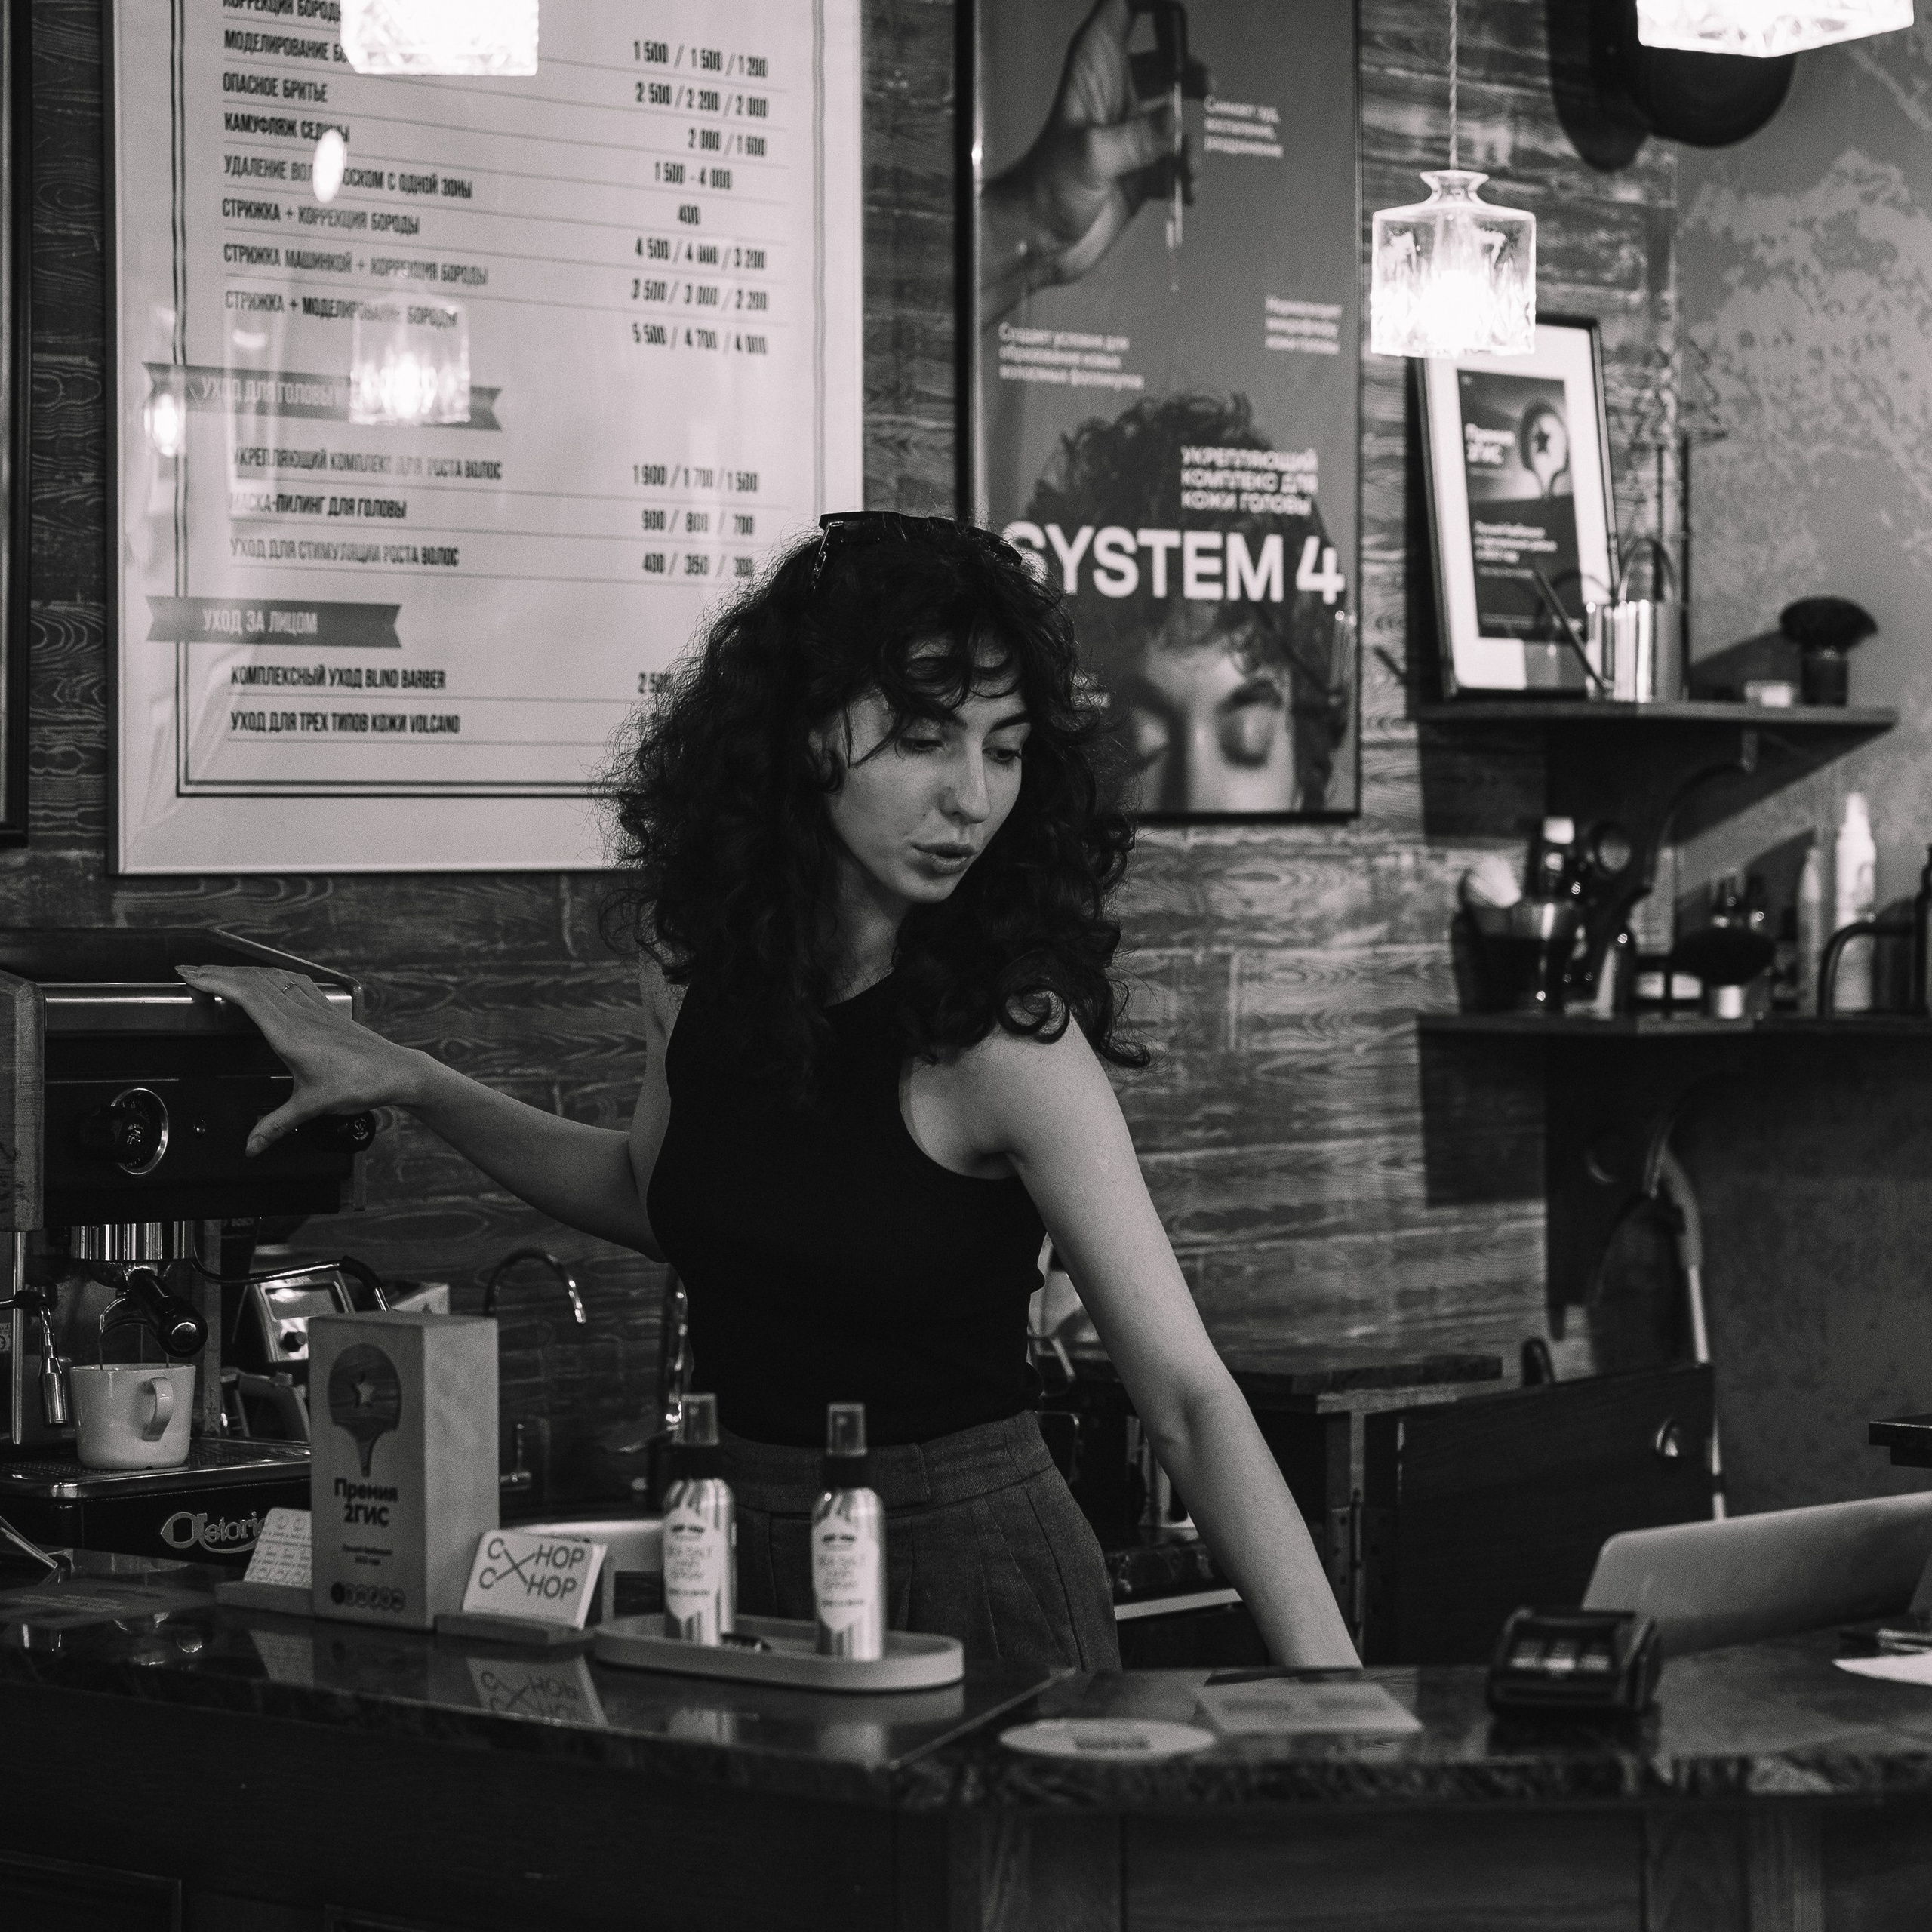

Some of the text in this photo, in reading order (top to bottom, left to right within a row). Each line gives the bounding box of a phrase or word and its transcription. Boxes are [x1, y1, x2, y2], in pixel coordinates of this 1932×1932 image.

[224, 29, 329, 61] МОДЕЛИРОВАНИЕ
[644, 40, 669, 64] 500
[223, 72, 328, 103] ОПАСНОЕ БРИТЬЕ
[648, 82, 672, 105] 500
[225, 112, 350, 143] КАМУФЛЯЖ СЕДЫ
[225, 155, 472, 199] УДАЛЕНИЕ ВОЛ ОСКОМ С ОДНОЙ ЗОНЫ
[223, 198, 281, 222] СТРИЖКА
[298, 206, 367, 231] КОРРЕКЦИЯ
[371, 211, 420, 237] БОРОДЫ
[224, 243, 281, 266] СТРИЖКА
[285, 248, 352, 273] МАШИНКОЙ
[441, 263, 488, 287] БОРОДЫ
[225, 290, 285, 312] СТРИЖКА
[302, 296, 401, 321] МОДЕЛИР
[244, 380, 275, 403] ДЛЯ
[330, 453, 392, 475] КОМПЛЕКС
[464, 459, 502, 479] ВОЛОС
[327, 496, 355, 517] ДЛЯ
[357, 497, 407, 518] ГОЛОВЫ
[1180, 490, 1312, 515] КОЖИ ГОЛОВЫ
[230, 539, 460, 567] УХОД ДЛЯ СТИМУЛЯЦИИ РОСТА ВОЛОС
[1002, 521, 1346, 605] SYSTEM 4
[202, 608, 318, 637] УХОД ЗА ЛИЦОМ
[231, 664, 446, 689] КОМПЛЕКСНЫЙ УХОД BLIND BARBER
[230, 711, 460, 734] УХОД ДЛЯ ТРЕХ ТИПОВ КОЖИ VOLCANO
[334, 1477, 398, 1503] Премия
[343, 1503, 390, 1527] 2ГИС
